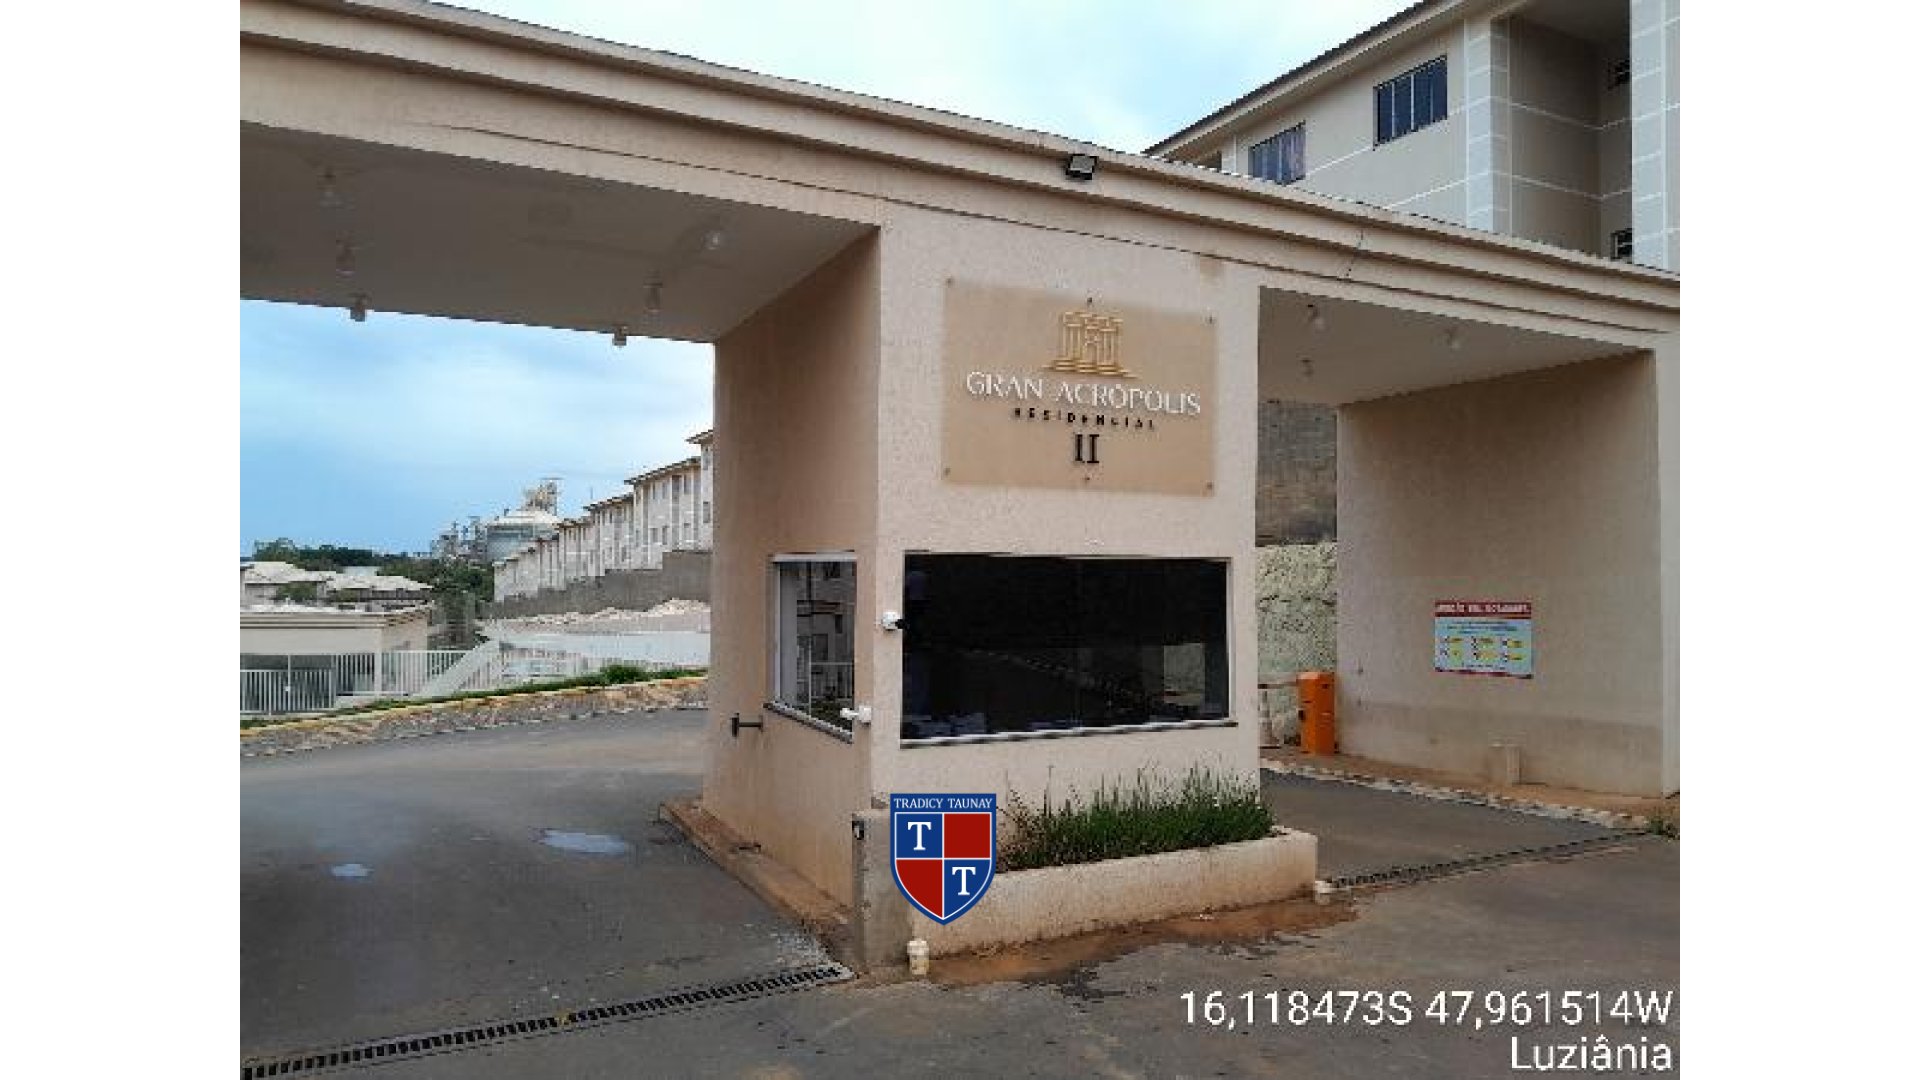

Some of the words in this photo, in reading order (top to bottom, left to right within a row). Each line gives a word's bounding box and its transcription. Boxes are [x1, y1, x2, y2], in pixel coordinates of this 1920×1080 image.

[966, 371, 1043, 400] GRAN
[1014, 407, 1155, 429] RESIDENCIAL
[1074, 434, 1099, 463] II
